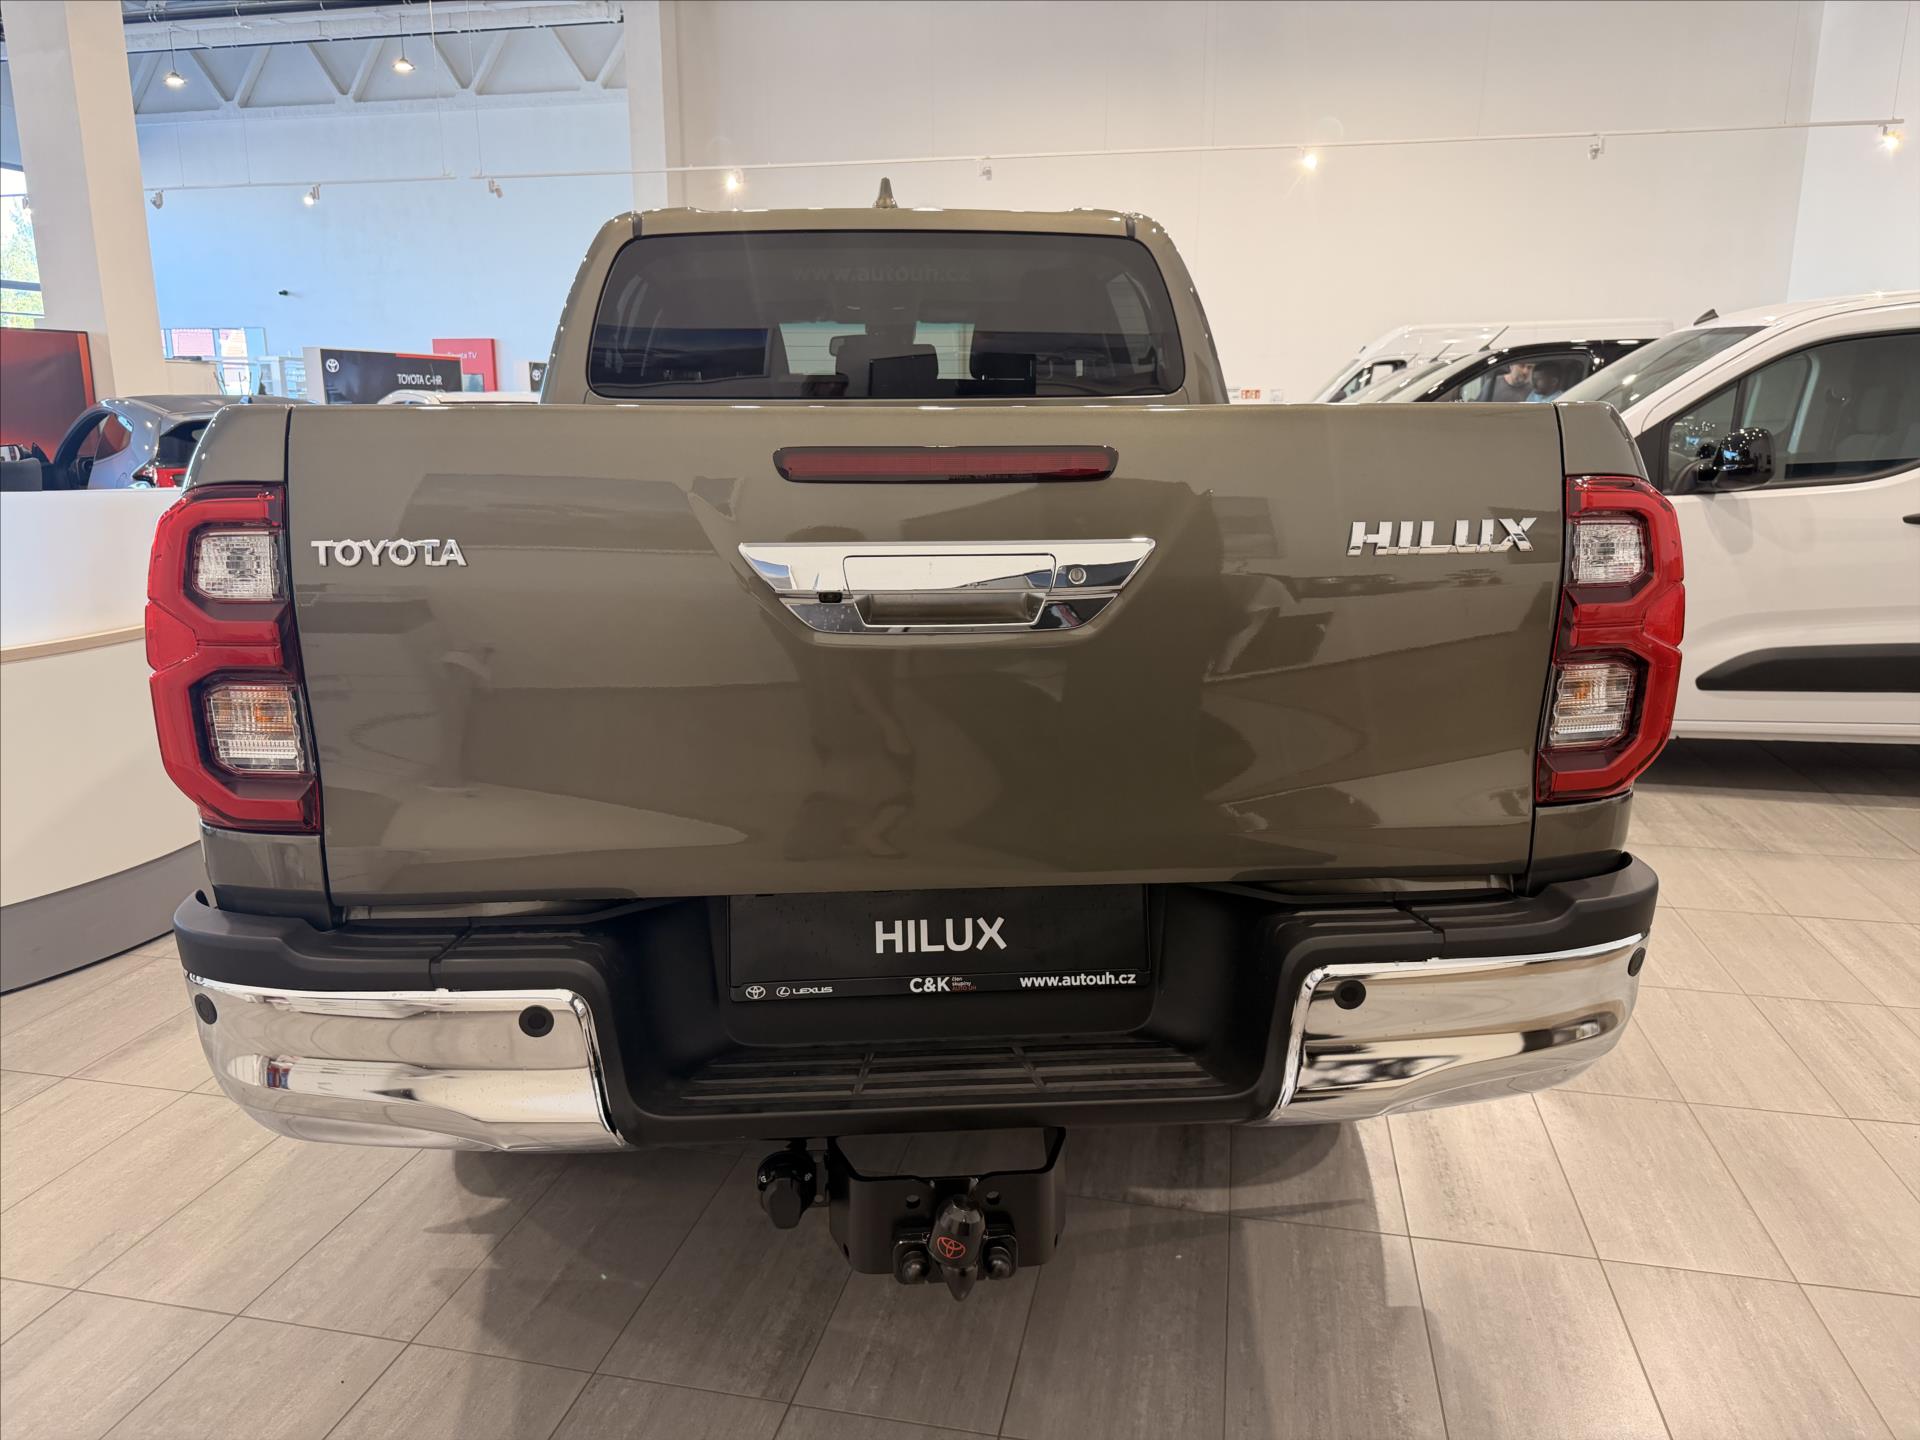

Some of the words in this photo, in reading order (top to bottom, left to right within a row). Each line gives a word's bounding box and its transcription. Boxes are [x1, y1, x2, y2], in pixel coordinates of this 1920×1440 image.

[397, 373, 424, 384] TOYOTA
[425, 374, 443, 385] C-HR
[1347, 517, 1537, 556] HILUX
[311, 538, 468, 567] TOYOTA
[875, 916, 1007, 954] HILUX
[909, 976, 951, 993] C&K
[1020, 971, 1136, 987] www.autouh.cz
[792, 986, 833, 994] LEXUS
